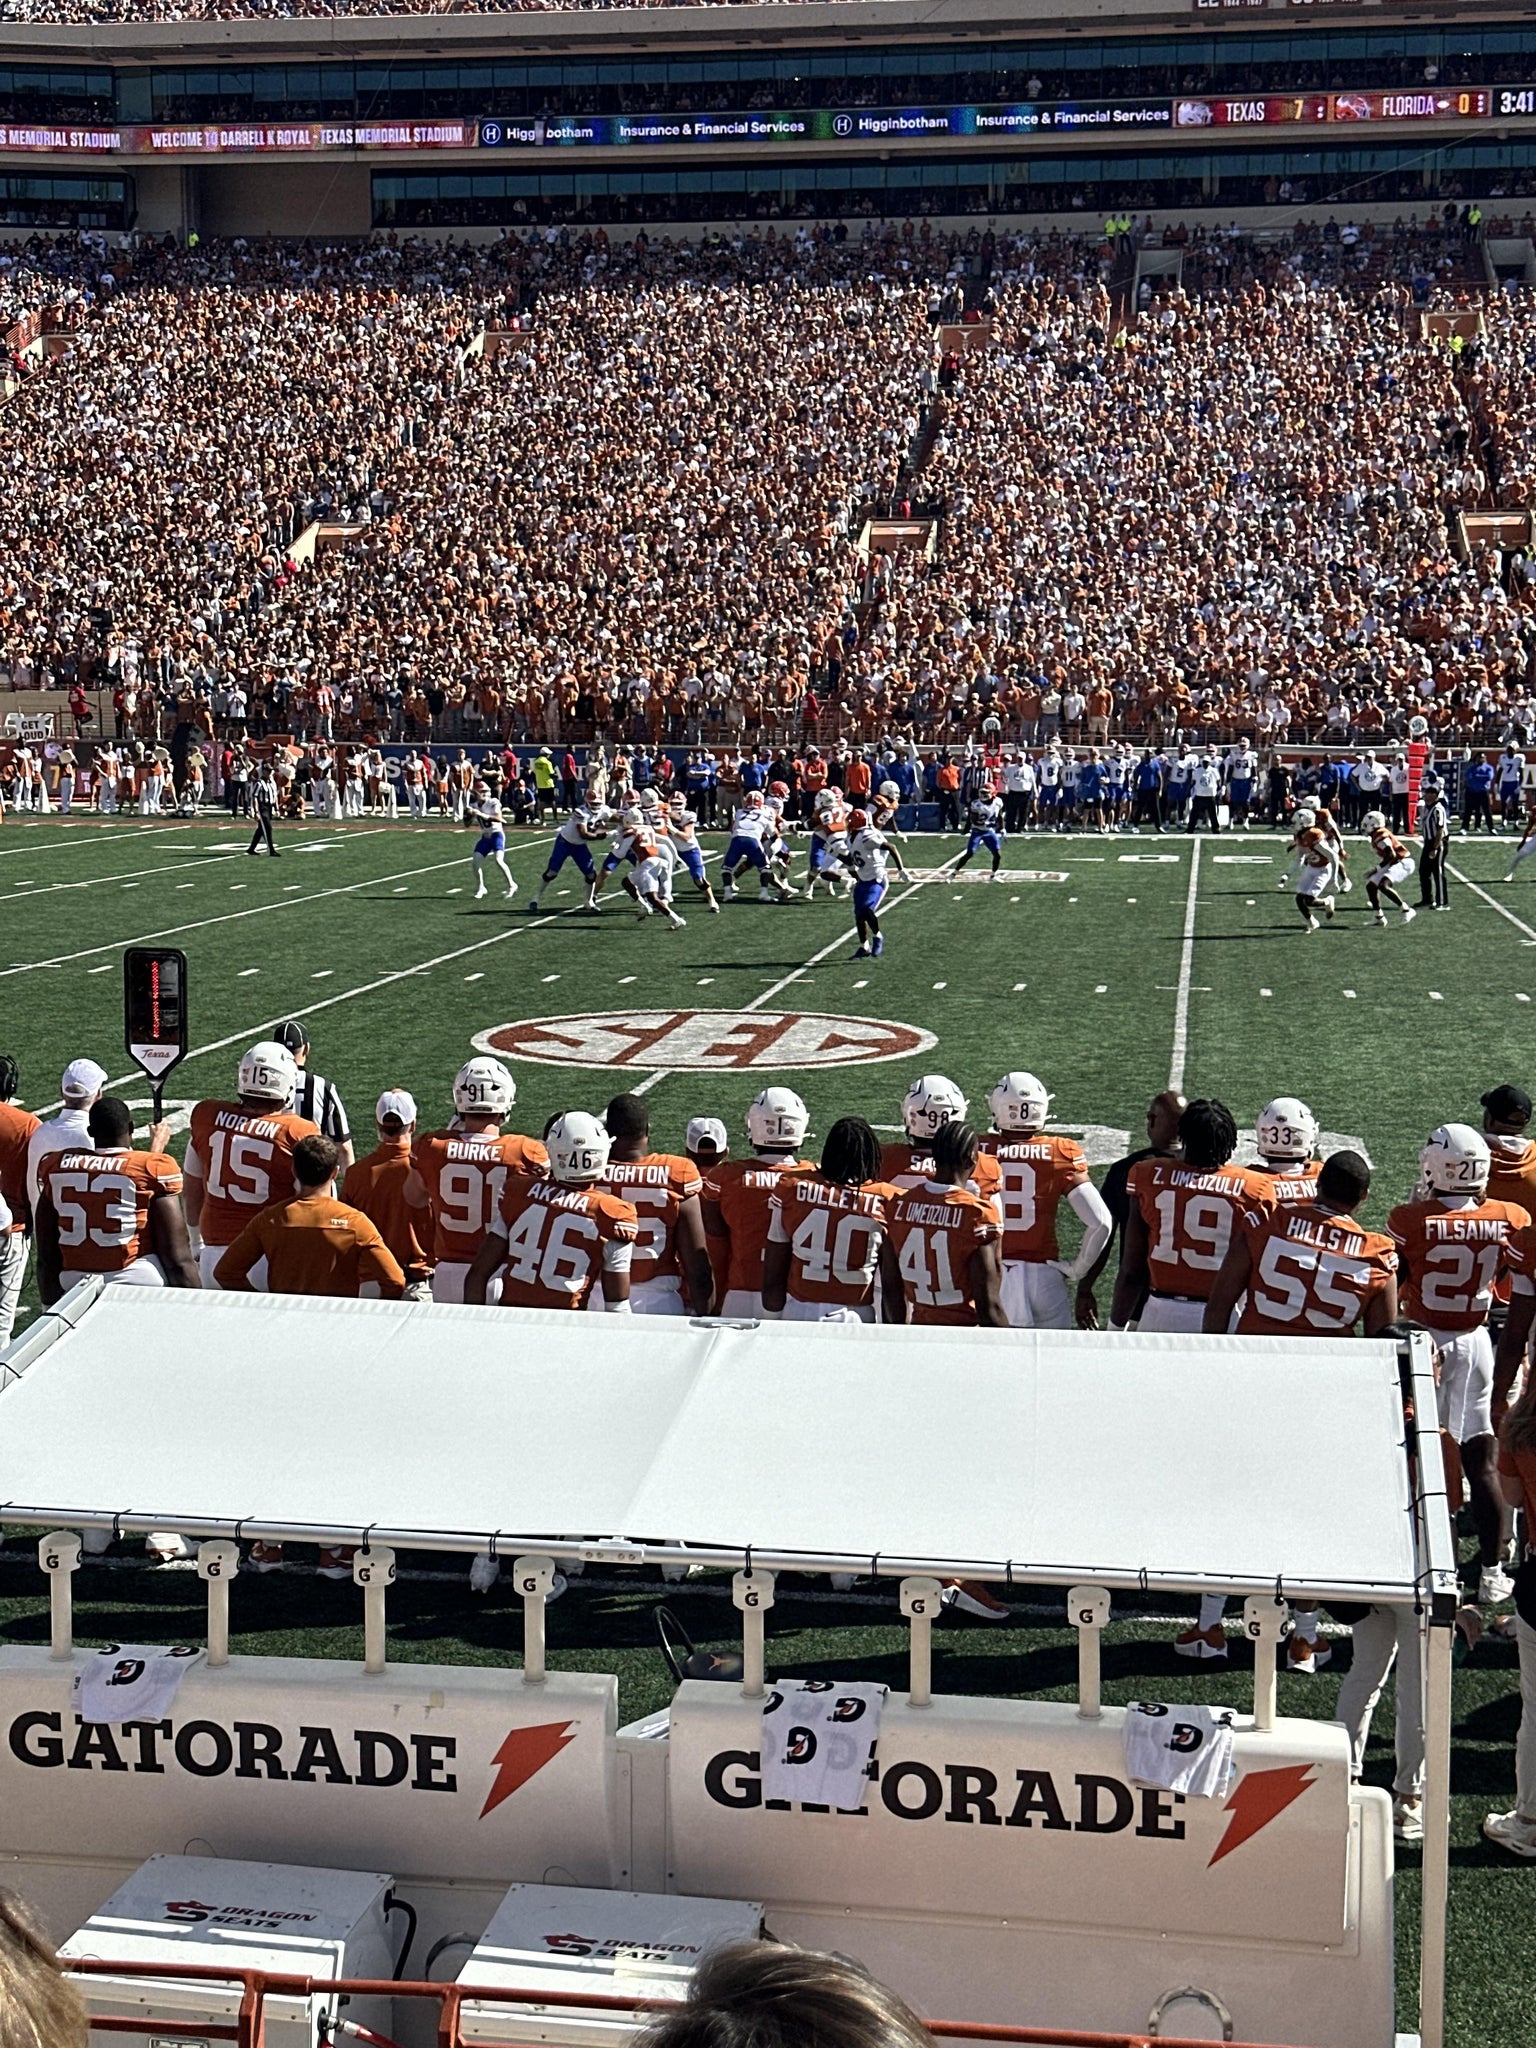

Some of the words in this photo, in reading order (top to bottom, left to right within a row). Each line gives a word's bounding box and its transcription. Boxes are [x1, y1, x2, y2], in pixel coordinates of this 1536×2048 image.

[1225, 103, 1265, 122] TEXAS
[1294, 100, 1303, 119] 7
[1382, 96, 1434, 117] FLORIDA
[1458, 94, 1470, 114] 0
[1500, 91, 1535, 114] 3:41
[858, 117, 948, 132] Higginbotham
[976, 113, 1038, 127] Insurance
[1041, 112, 1051, 124] &
[1054, 109, 1110, 124] Financial
[1113, 109, 1170, 122] Services
[152, 132, 203, 148] WELCOME
[205, 131, 218, 147] TO
[220, 130, 265, 147] DARRELL
[277, 129, 311, 145] ROYAL
[320, 128, 353, 145] TEXAS
[355, 127, 411, 143] MEMORIAL
[414, 127, 462, 143] STADIUM
[507, 126, 593, 142] Higgbotham
[620, 124, 680, 137] Insurance
[682, 123, 692, 136] &
[694, 121, 749, 136] Financial
[751, 120, 805, 134] Services
[9, 130, 68, 147] MEMORIAL
[70, 132, 120, 148] STADIUM
[21, 721, 39, 730] GET
[486, 1011, 922, 1069] SEC
[252, 1066, 268, 1085] 15
[468, 1083, 485, 1103] 91
[1020, 1103, 1029, 1119] 8
[215, 1111, 281, 1139] NORTON
[1270, 1126, 1291, 1146] 33
[60, 1153, 128, 1171] BRYANT
[447, 1142, 503, 1162] BURKE
[568, 1150, 592, 1170] 46
[996, 1144, 1052, 1160] MOORE
[207, 1131, 275, 1204] 15
[1152, 1167, 1165, 1185] Z.
[1458, 1160, 1476, 1180] 21
[439, 1163, 508, 1233] 91
[527, 1182, 590, 1213] AKANA
[796, 1181, 885, 1215] GULLETTE
[1001, 1162, 1036, 1231] 8
[49, 1173, 136, 1247] 53
[1151, 1190, 1234, 1271] 19
[1286, 1216, 1341, 1251] HILLS
[1425, 1219, 1509, 1241] FILSAIME
[508, 1204, 599, 1292] 46
[792, 1208, 884, 1284] 40
[899, 1227, 964, 1306] 41
[1254, 1235, 1371, 1329] 55
[1421, 1244, 1501, 1312] 21
[46, 1554, 59, 1569] G
[206, 1562, 221, 1577] G
[358, 1567, 371, 1582] G
[522, 1577, 537, 1592] G
[744, 1591, 759, 1607] G
[911, 1599, 925, 1614] G
[1079, 1609, 1093, 1624] G
[1248, 1621, 1261, 1637] G
[8, 1710, 458, 1793] GATORADE
[704, 1749, 1186, 1840] GORADE
[209, 1915, 282, 1929] SEATS
[219, 1906, 318, 1922] DRAGON
[595, 1949, 670, 1961] SEATS
[603, 1939, 703, 1954] DRAGON
